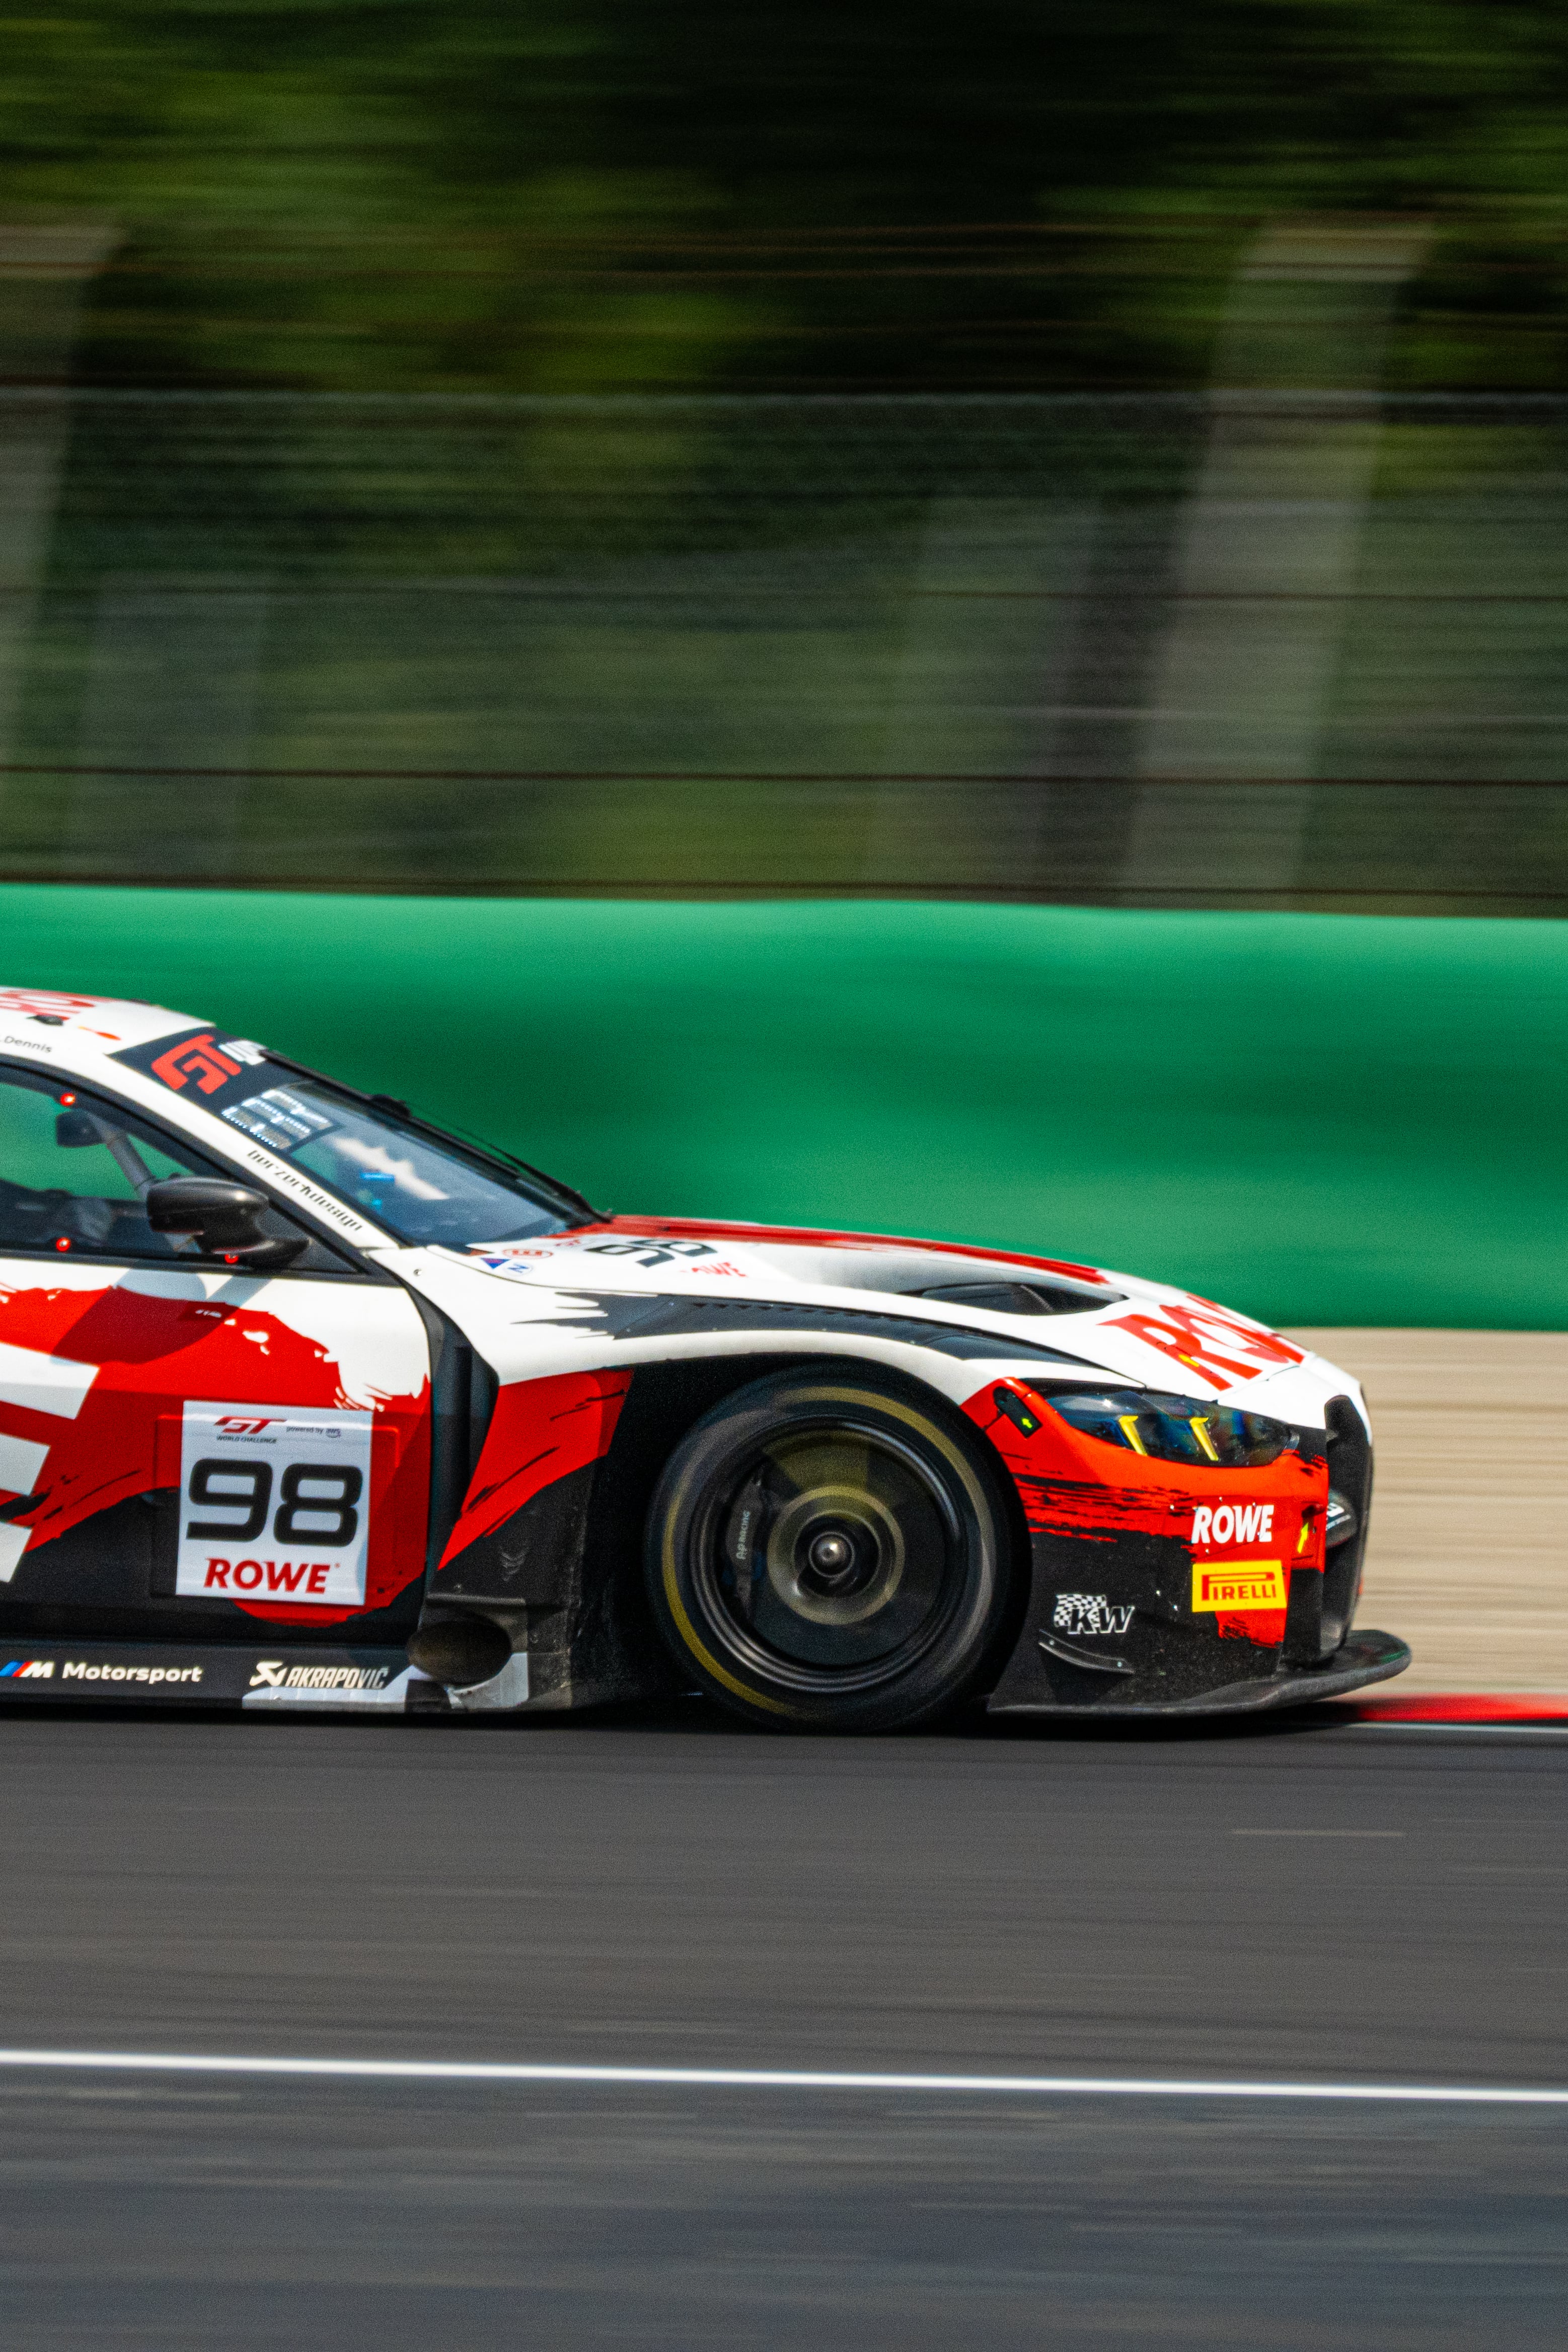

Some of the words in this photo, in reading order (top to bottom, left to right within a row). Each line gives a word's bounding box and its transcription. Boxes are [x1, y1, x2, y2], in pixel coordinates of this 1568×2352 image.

[4, 1036, 52, 1053] Dennis
[151, 1034, 242, 1095] GT
[213, 1415, 287, 1434] GT
[242, 1436, 277, 1444] CHALLENGE
[186, 1458, 363, 1548] 98
[1191, 1505, 1275, 1544] ROWE
[203, 1557, 330, 1595] ROWE
[1202, 1572, 1277, 1601] PIRELLI
[1067, 1605, 1136, 1635] KW
[61, 1661, 202, 1684] Motorsport
